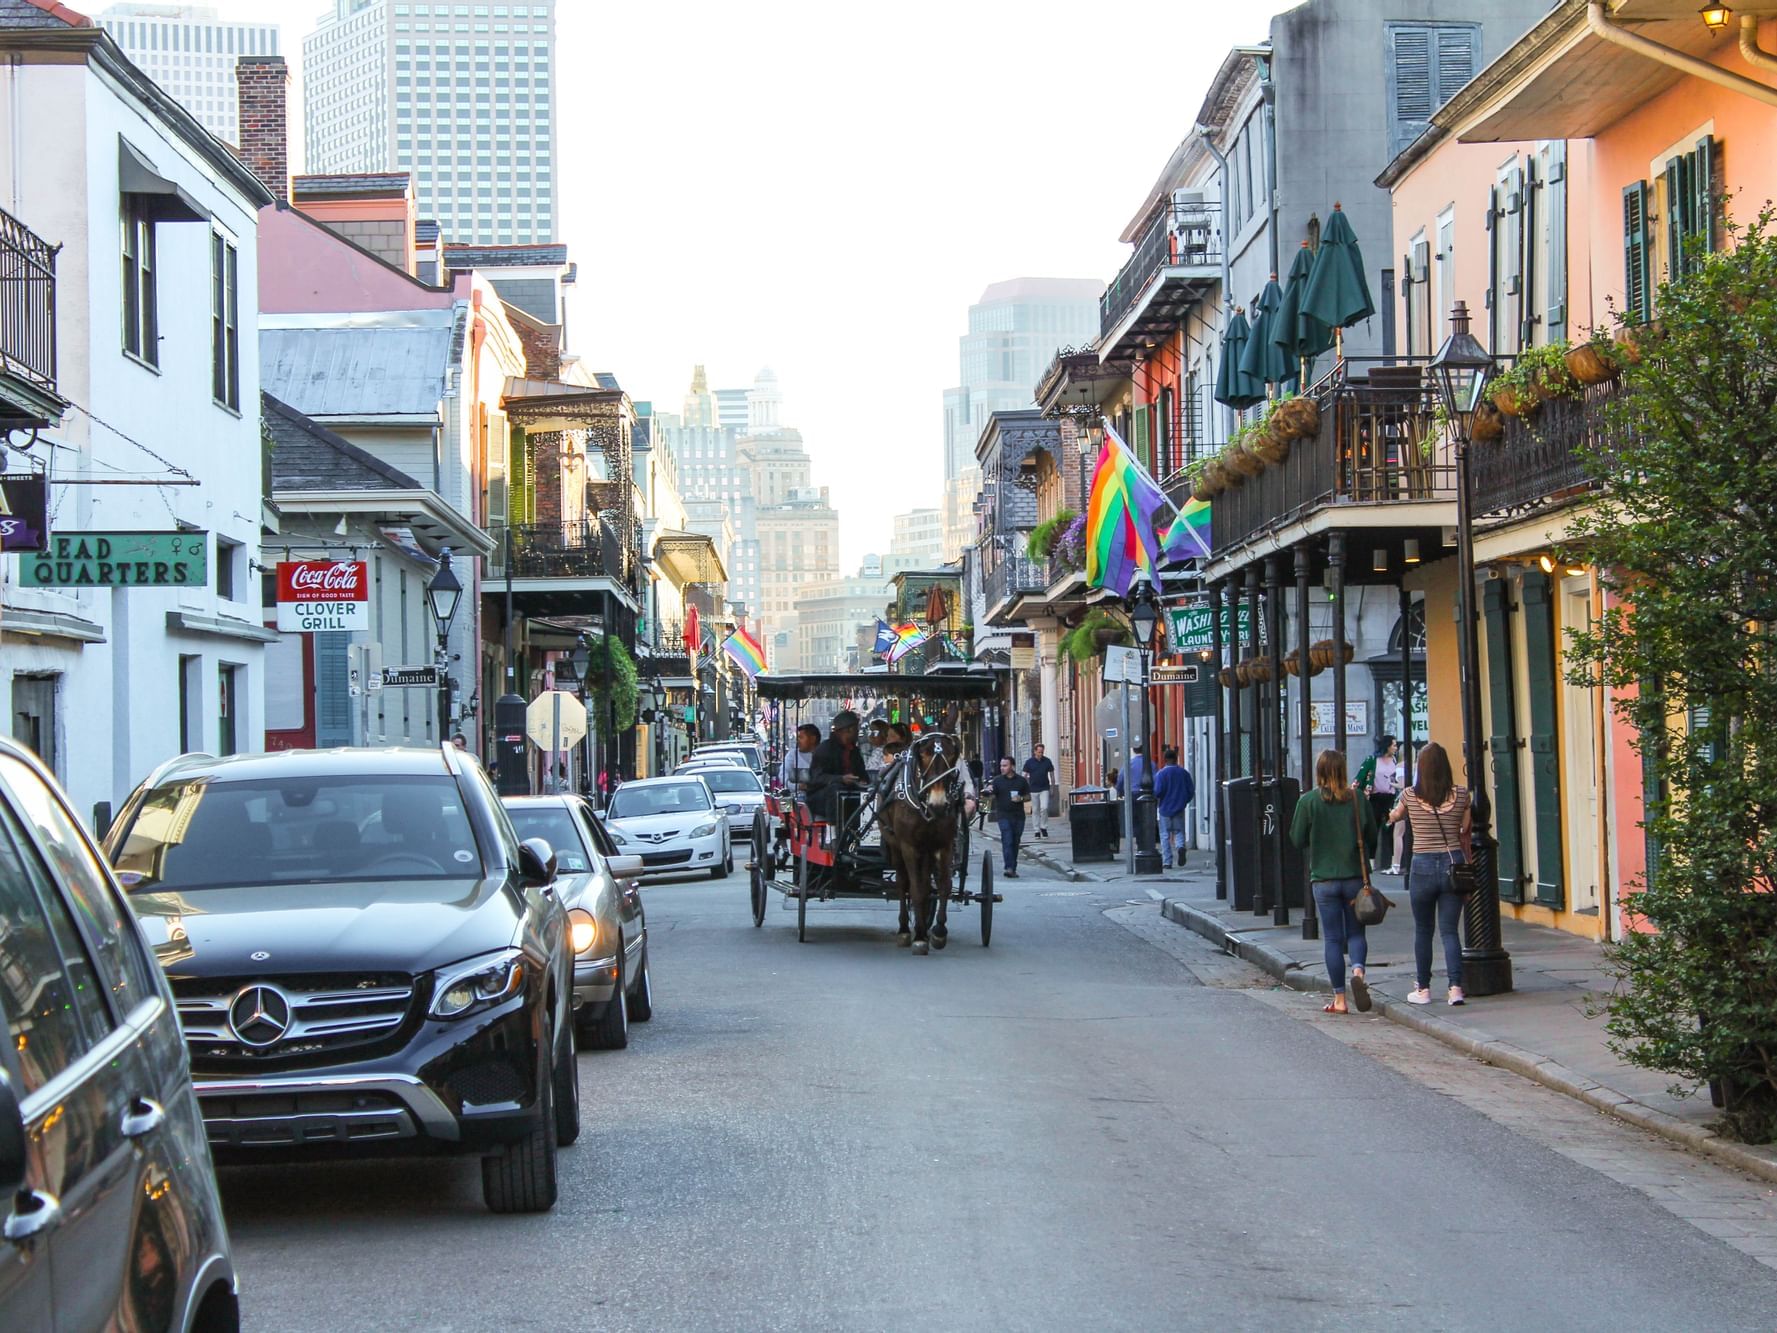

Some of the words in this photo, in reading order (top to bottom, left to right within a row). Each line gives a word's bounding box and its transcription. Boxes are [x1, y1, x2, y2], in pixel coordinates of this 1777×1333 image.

[34, 562, 188, 584] QUARTERS
[290, 563, 360, 591] Coca-Cola
[295, 603, 356, 615] CLOVER
[302, 618, 346, 630] GRILL
[1176, 611, 1228, 638] WASHIG
[1153, 671, 1196, 681] Dumaine
